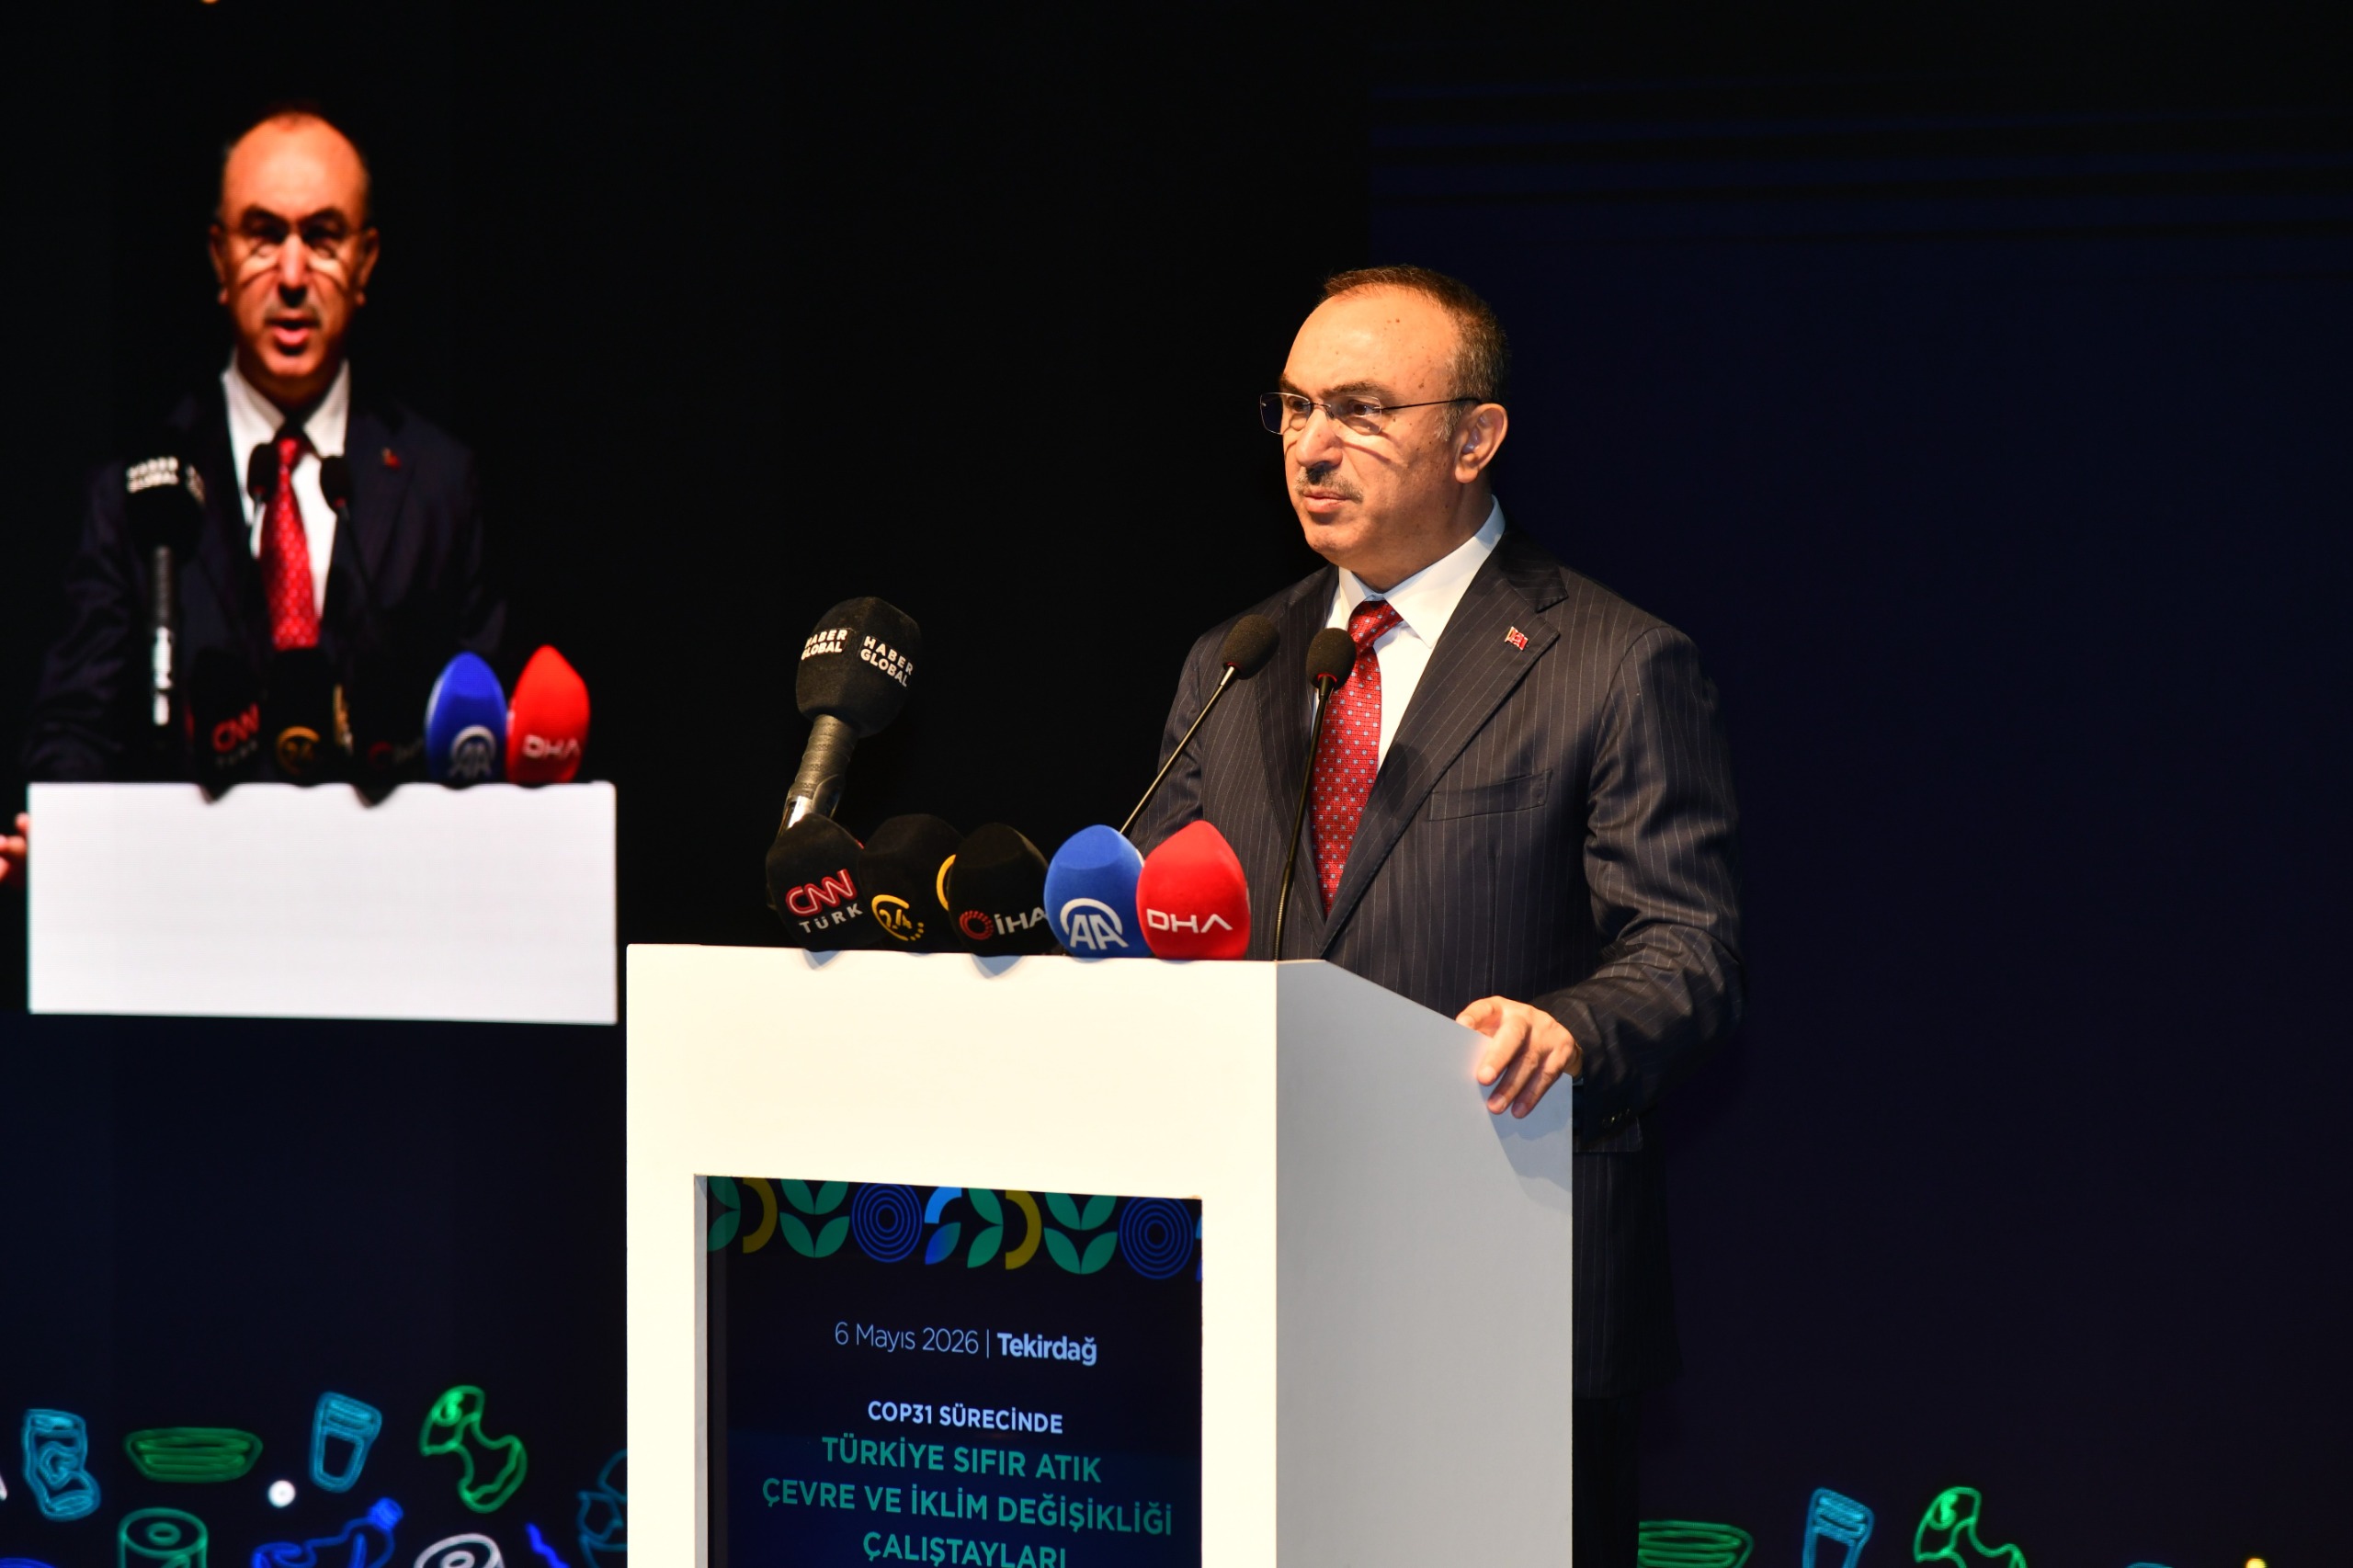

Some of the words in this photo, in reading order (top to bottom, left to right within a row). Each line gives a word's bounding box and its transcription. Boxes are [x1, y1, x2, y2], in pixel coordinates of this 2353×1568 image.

[801, 641, 843, 661] GLOBAL
[805, 630, 847, 649] HABER
[864, 636, 914, 676] HABER
[860, 648, 908, 687] GLOBAL
[523, 734, 580, 758] DHA
[786, 869, 858, 916] CNN
[799, 903, 863, 933] TÜRK
[1146, 908, 1233, 934] DHA
[835, 1322, 848, 1345] 6
[857, 1324, 915, 1352] Mayıs
[923, 1327, 979, 1354] 2026
[997, 1332, 1097, 1367] Tekirdağ
[868, 1401, 932, 1424] COP31
[939, 1402, 1063, 1433] SÜRECİNDE
[822, 1433, 944, 1471] TÜRKİYE
[954, 1446, 1025, 1476] SIFIR
[1036, 1454, 1101, 1483] ATIK
[763, 1478, 855, 1509] ÇEVRE
[865, 1485, 901, 1513] VE
[911, 1483, 987, 1520] İKLİM
[998, 1494, 1172, 1535] DEĞİŞİKLİĞİ
[863, 1532, 1066, 1568] ÇALIŞTAYLARI
